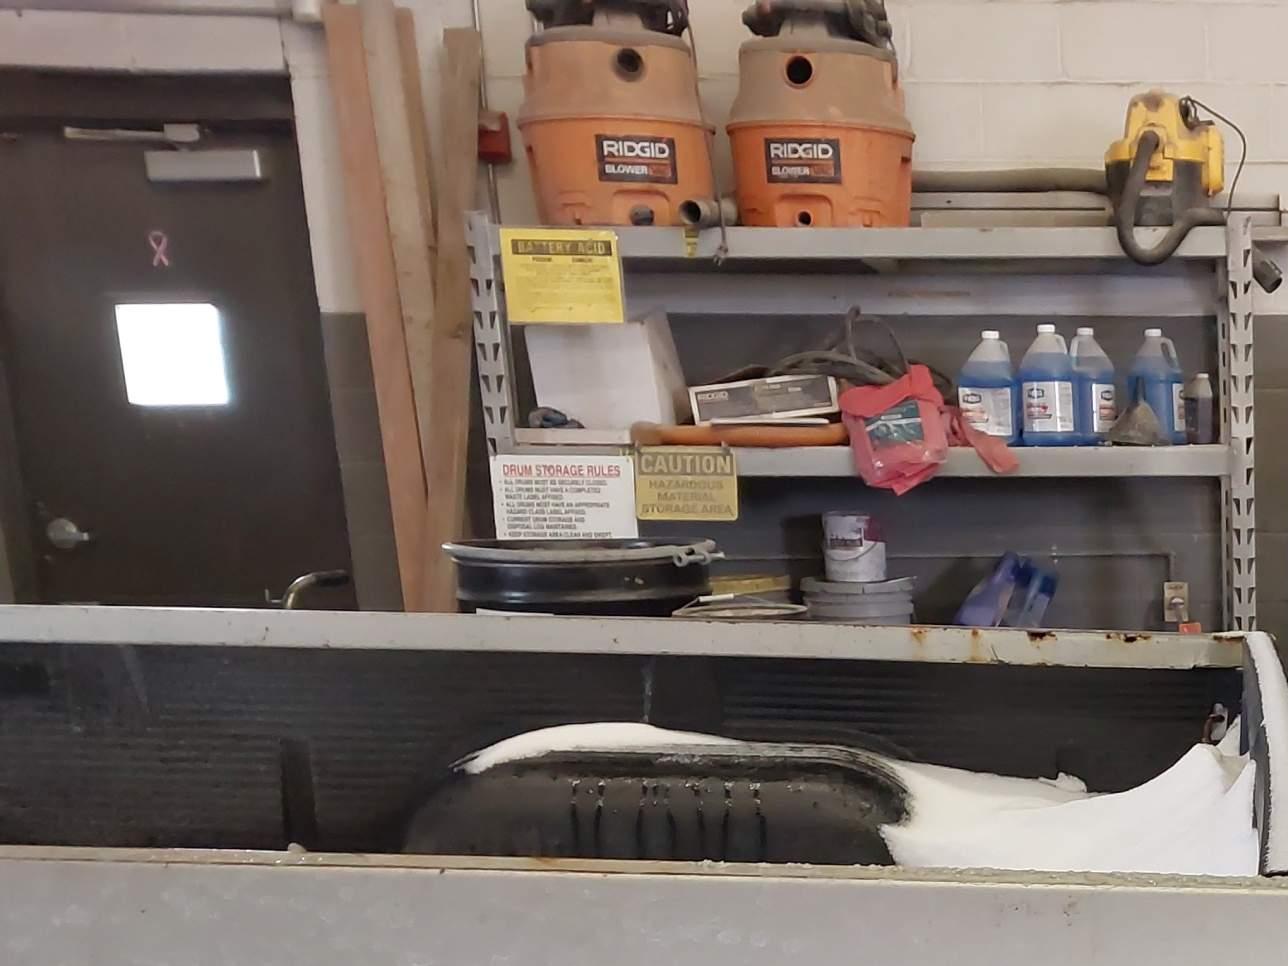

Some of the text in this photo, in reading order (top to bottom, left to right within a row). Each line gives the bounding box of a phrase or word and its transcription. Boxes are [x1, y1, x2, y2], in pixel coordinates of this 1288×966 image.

[602, 140, 669, 158] RIDGID
[770, 143, 833, 159] RIDGID
[604, 164, 648, 175] BLOWER
[517, 241, 605, 255] BATTERY ACID
[640, 454, 731, 473] CAUTION
[502, 464, 621, 477] DRUM STORAGE RULES
[648, 480, 724, 490] HAZARDOUS
[656, 492, 717, 502] MATERIAL
[641, 503, 732, 514] STORAGE AREA
